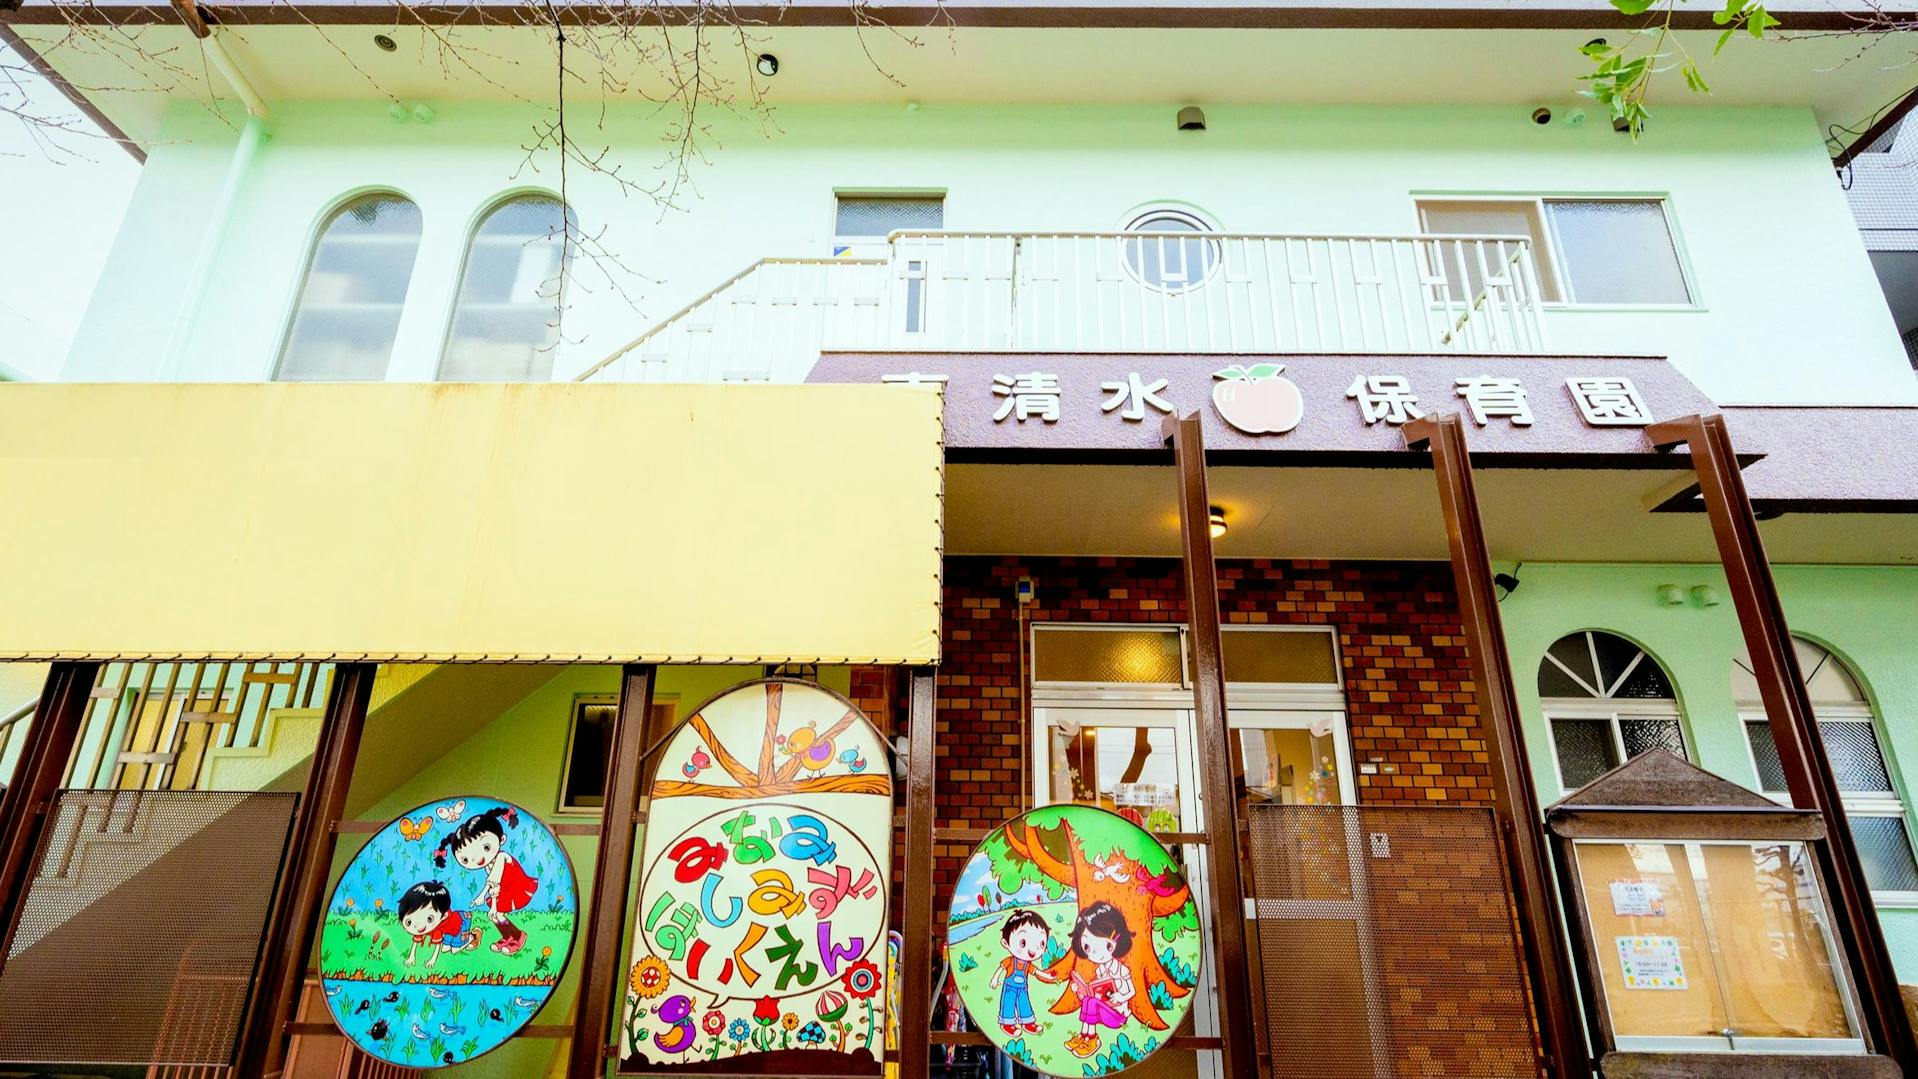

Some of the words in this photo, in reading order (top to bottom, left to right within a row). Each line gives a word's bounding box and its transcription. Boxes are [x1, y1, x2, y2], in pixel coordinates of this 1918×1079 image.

[881, 371, 1174, 423] 清水
[1346, 374, 1656, 426] 保育園
[668, 810, 837, 884] みなみ
[700, 865, 878, 929] しみず
[645, 890, 865, 991] ほいくえん
